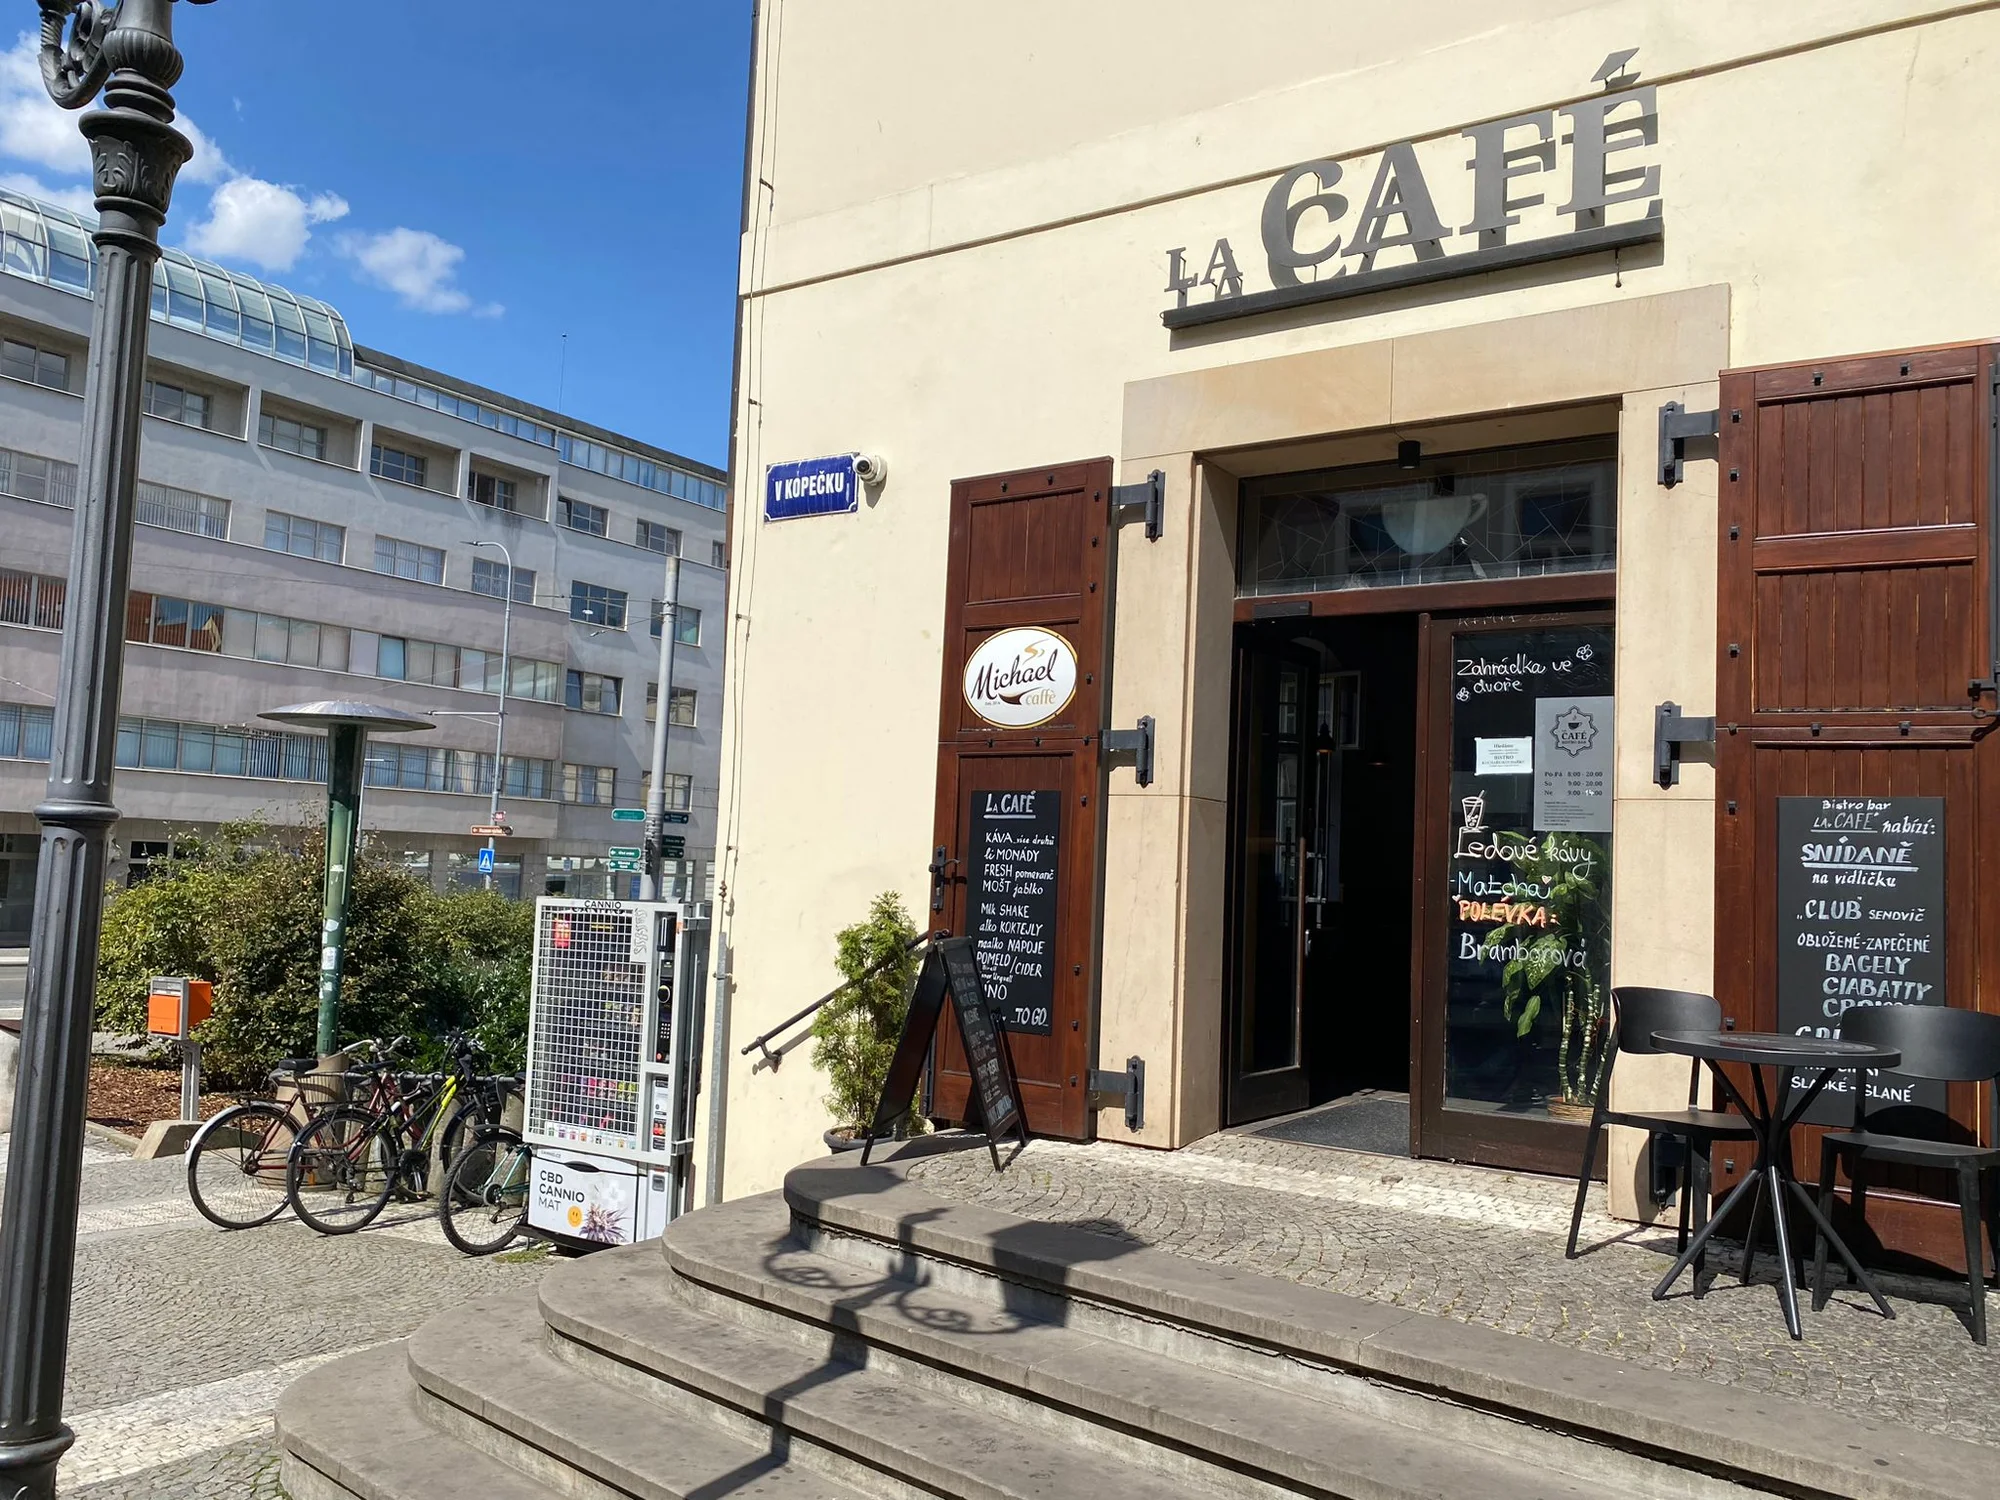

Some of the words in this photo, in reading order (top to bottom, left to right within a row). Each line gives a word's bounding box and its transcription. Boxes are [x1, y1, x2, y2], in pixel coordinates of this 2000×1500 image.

[1164, 237, 1243, 293] LA
[1260, 47, 1662, 268] CAFÉ
[774, 480, 783, 502] V
[784, 470, 845, 500] KOPEČKU
[970, 648, 1058, 701] Michael
[1456, 653, 1547, 677] Zahrádka
[1552, 659, 1574, 673] ve
[1472, 677, 1523, 694] dvoře
[1561, 729, 1587, 741] CAFÉ
[1000, 790, 1037, 813] CAFÉ
[1822, 800, 1864, 811] Bistro
[1867, 800, 1892, 811] bar
[1834, 811, 1880, 831] CAFÉ
[1882, 815, 1936, 835] nabízí:
[1453, 826, 1540, 862] Ledové
[1549, 834, 1598, 881] kávy
[1800, 835, 1915, 864] SNÍDANĚ
[984, 864, 1013, 877] FRESH
[1015, 869, 1055, 881] pomeranč
[1811, 872, 1829, 884] na
[1834, 869, 1897, 888] vidličku
[982, 878, 1012, 893] MOŠT
[1013, 882, 1044, 899] jablko
[1457, 870, 1551, 900] Matcha
[584, 900, 622, 910] CANNIO
[999, 904, 1030, 918] SHAKE
[979, 918, 998, 932] alko
[1000, 921, 1044, 936] KOKTEJLY
[1458, 931, 1587, 970] Bramborová
[1825, 953, 1912, 976] BAGELY
[1822, 976, 1934, 1001] CIABATTY
[539, 1169, 564, 1185] CBD
[537, 1196, 562, 1212] MAT
[538, 1183, 586, 1204] CANNIO
